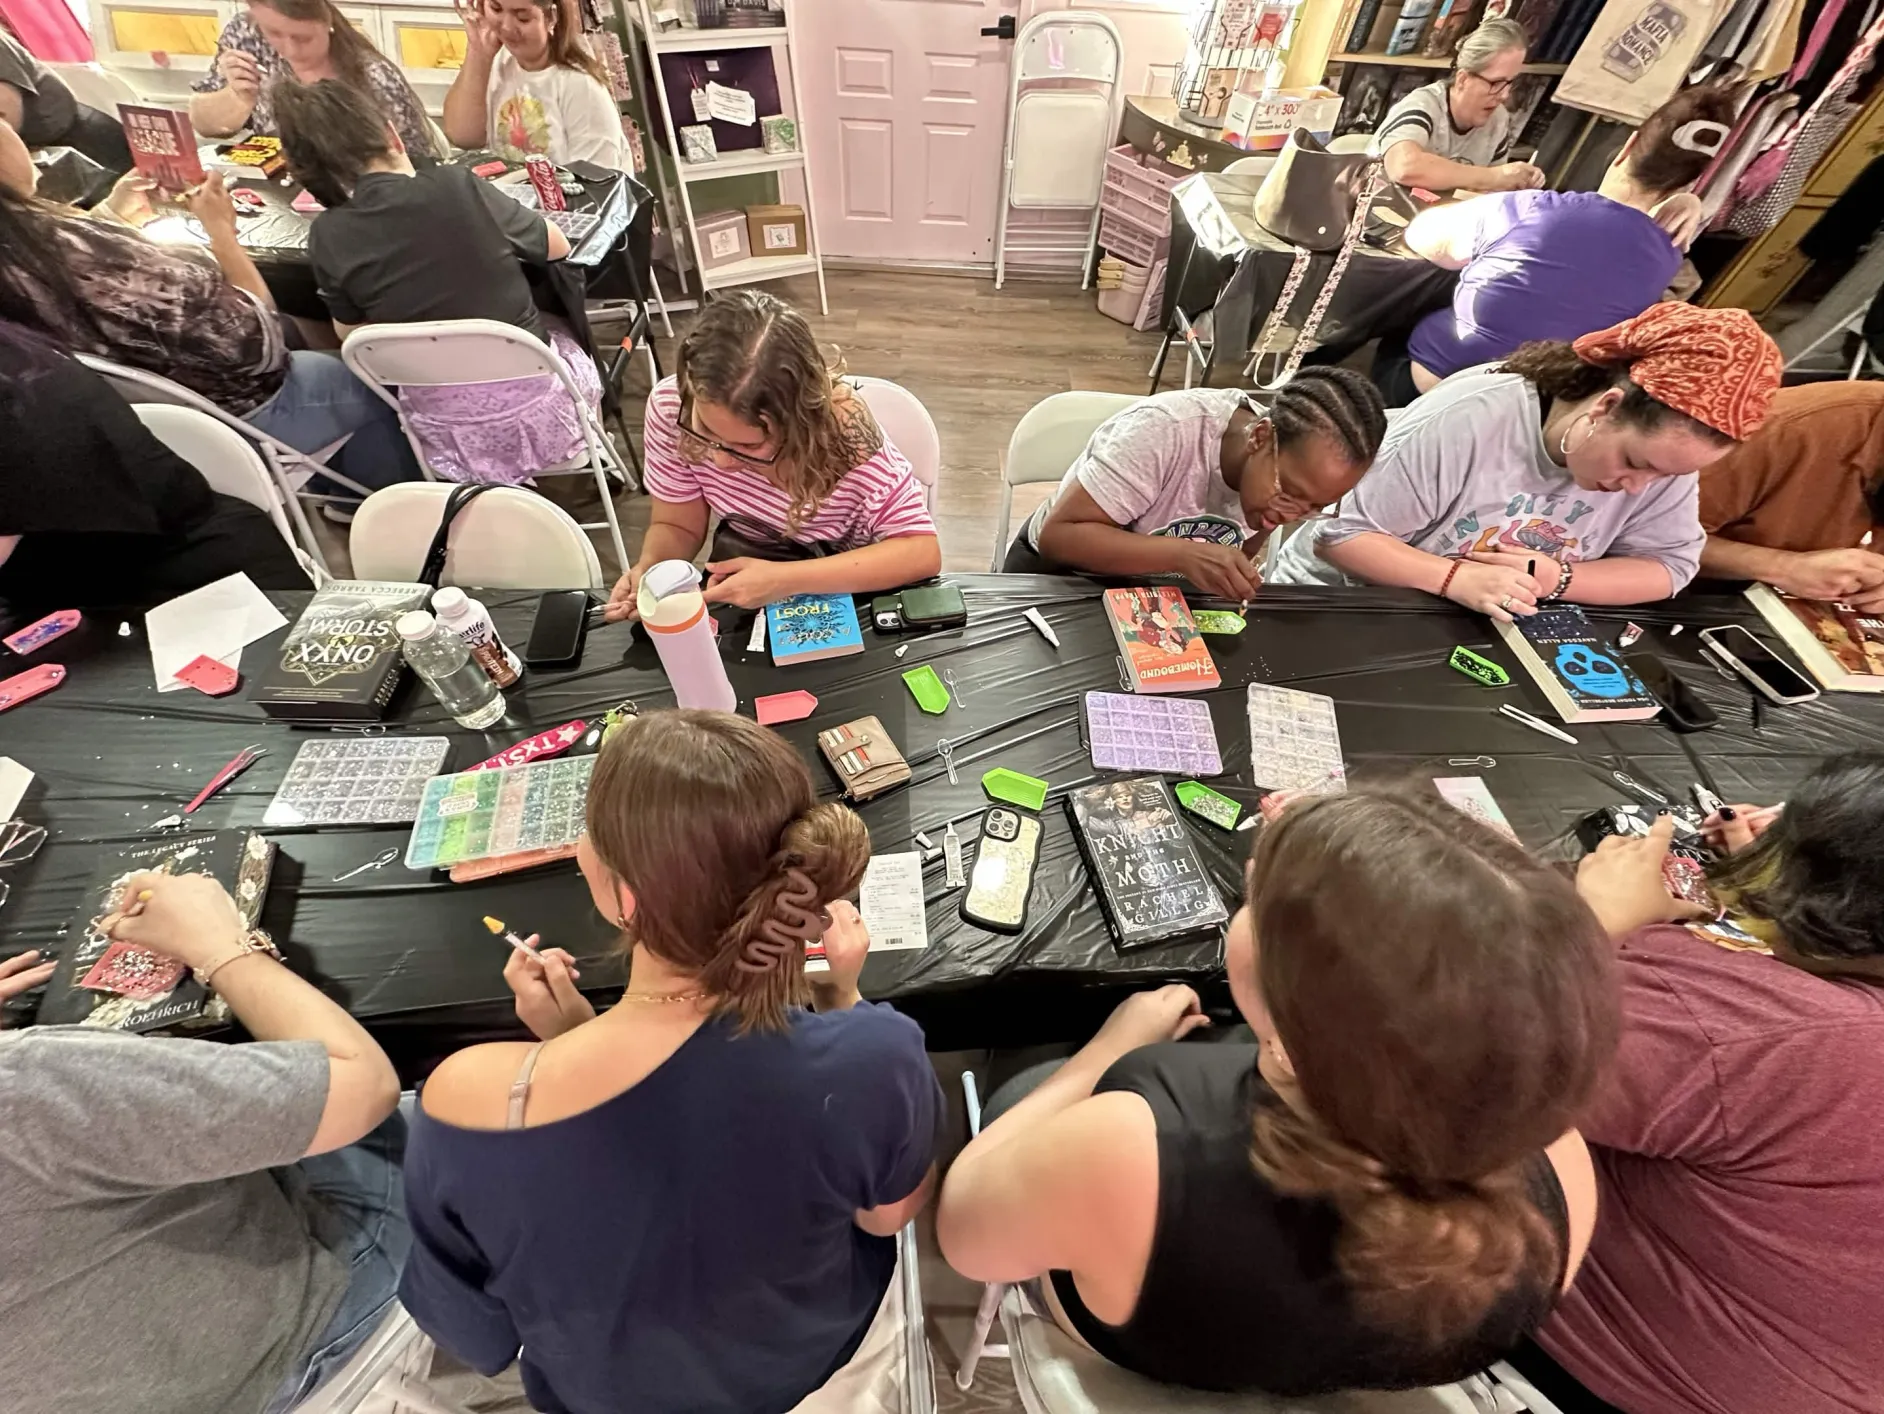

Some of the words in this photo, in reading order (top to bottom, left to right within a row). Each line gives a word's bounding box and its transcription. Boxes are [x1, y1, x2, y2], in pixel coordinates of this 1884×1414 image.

[1640, 15, 1671, 44] MAFIA
[1621, 29, 1655, 66] ROMANCE
[774, 602, 830, 620] FROST
[307, 618, 393, 637] STORM
[290, 642, 375, 664] ONYX
[1140, 657, 1214, 679] HOMEBOUND
[1094, 823, 1181, 854] KNIGHT
[131, 850, 150, 858] THE
[1115, 858, 1191, 888] MOTH
[1124, 886, 1204, 912] RACHEL
[1134, 899, 1205, 924] GILLIG
